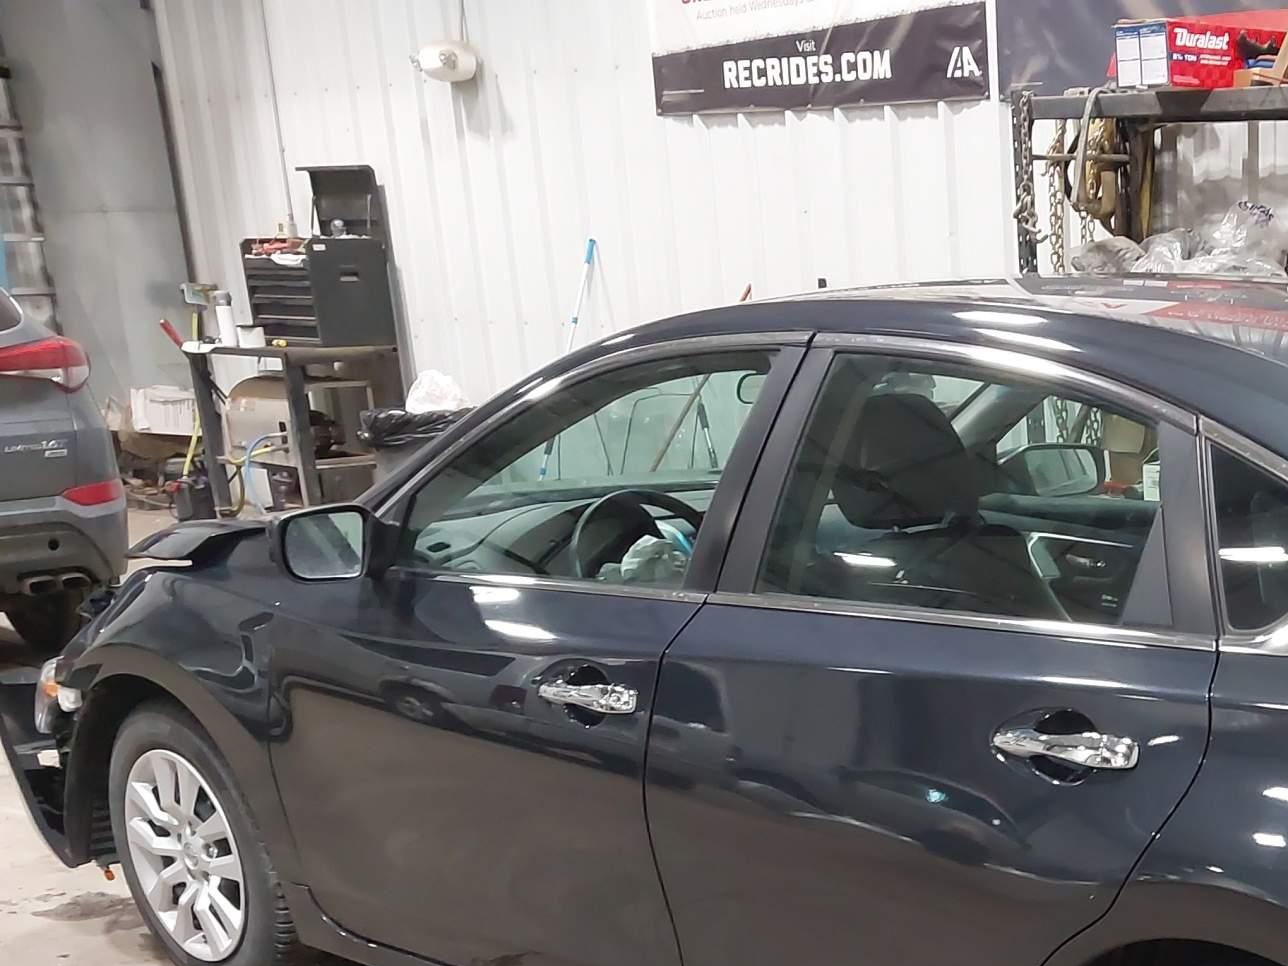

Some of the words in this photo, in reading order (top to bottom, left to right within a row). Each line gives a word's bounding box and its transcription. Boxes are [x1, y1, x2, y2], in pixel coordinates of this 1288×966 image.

[796, 39, 816, 52] Visit
[1173, 27, 1230, 50] Duralast
[723, 49, 892, 89] RECRIDES.COM
